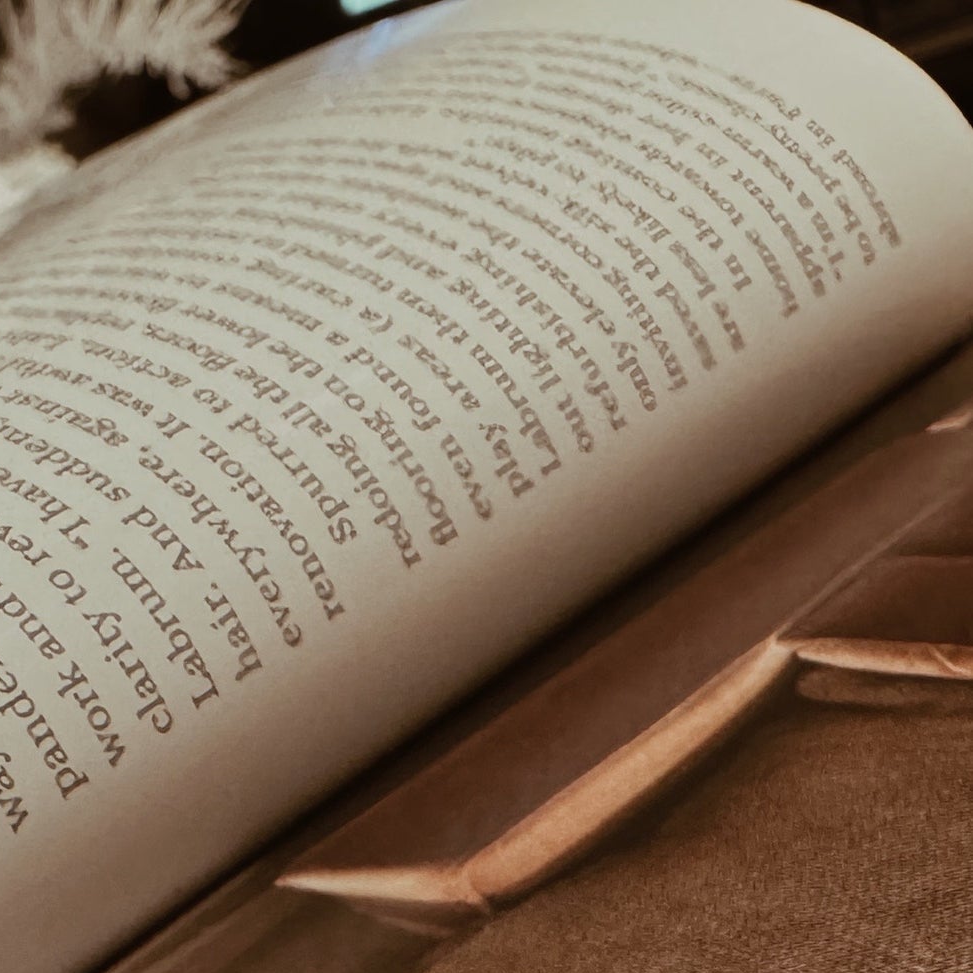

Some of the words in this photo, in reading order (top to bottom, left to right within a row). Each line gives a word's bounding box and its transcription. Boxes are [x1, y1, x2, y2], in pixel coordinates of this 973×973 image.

[695, 142, 729, 170] in
[677, 206, 724, 252] the
[796, 190, 815, 210] a
[835, 196, 862, 234] be
[613, 236, 661, 282] the
[730, 168, 826, 297] apparent
[856, 231, 876, 267] to
[520, 248, 616, 336] elevate
[668, 240, 717, 301] less
[723, 253, 753, 293] In
[324, 330, 351, 347] a
[358, 305, 394, 334] (a
[396, 288, 470, 345] then
[447, 279, 562, 394] lighting
[461, 247, 627, 431] refurbishing
[601, 266, 688, 391] inviting
[653, 280, 718, 371] saved
[712, 301, 746, 352] are
[232, 365, 291, 405] the
[266, 340, 324, 379] the
[343, 346, 442, 432] found
[397, 334, 481, 412] areas
[610, 341, 658, 412] only
[0, 389, 130, 447] against
[90, 382, 155, 418] was
[192, 388, 233, 415] to
[280, 401, 333, 438] all
[323, 373, 366, 413] on
[469, 344, 562, 476] Labrum
[556, 393, 595, 454] out
[154, 412, 192, 440] It
[227, 413, 358, 545] Spurred
[361, 407, 459, 546] flooring
[439, 433, 493, 522] even
[478, 422, 535, 499] play
[199, 434, 345, 621] renovation.
[326, 433, 422, 569] redoing
[58, 515, 91, 551] “I
[121, 504, 205, 571] And
[138, 446, 302, 648] everywhere,
[47, 568, 88, 606] to
[111, 547, 220, 709] Labrum.
[204, 582, 263, 682] hair.
[82, 612, 174, 734] clarity
[57, 660, 126, 768] work
